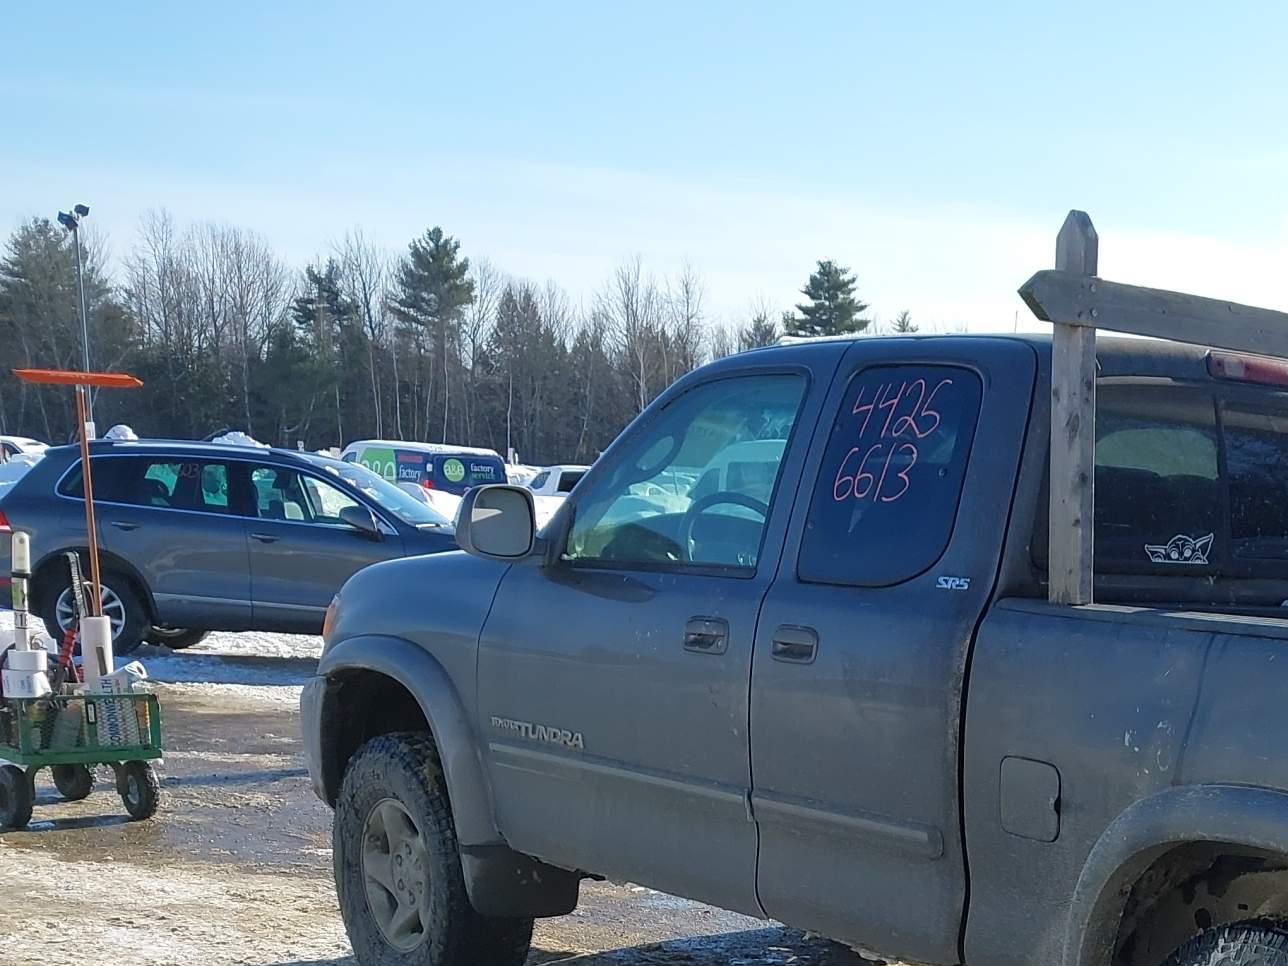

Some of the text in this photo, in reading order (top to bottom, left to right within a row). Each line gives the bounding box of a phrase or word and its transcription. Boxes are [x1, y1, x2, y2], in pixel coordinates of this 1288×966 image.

[852, 379, 952, 438] 4425
[400, 464, 422, 481] factory
[470, 462, 494, 474] factory
[833, 442, 918, 502] 6613
[514, 720, 584, 749] TUNDRA
